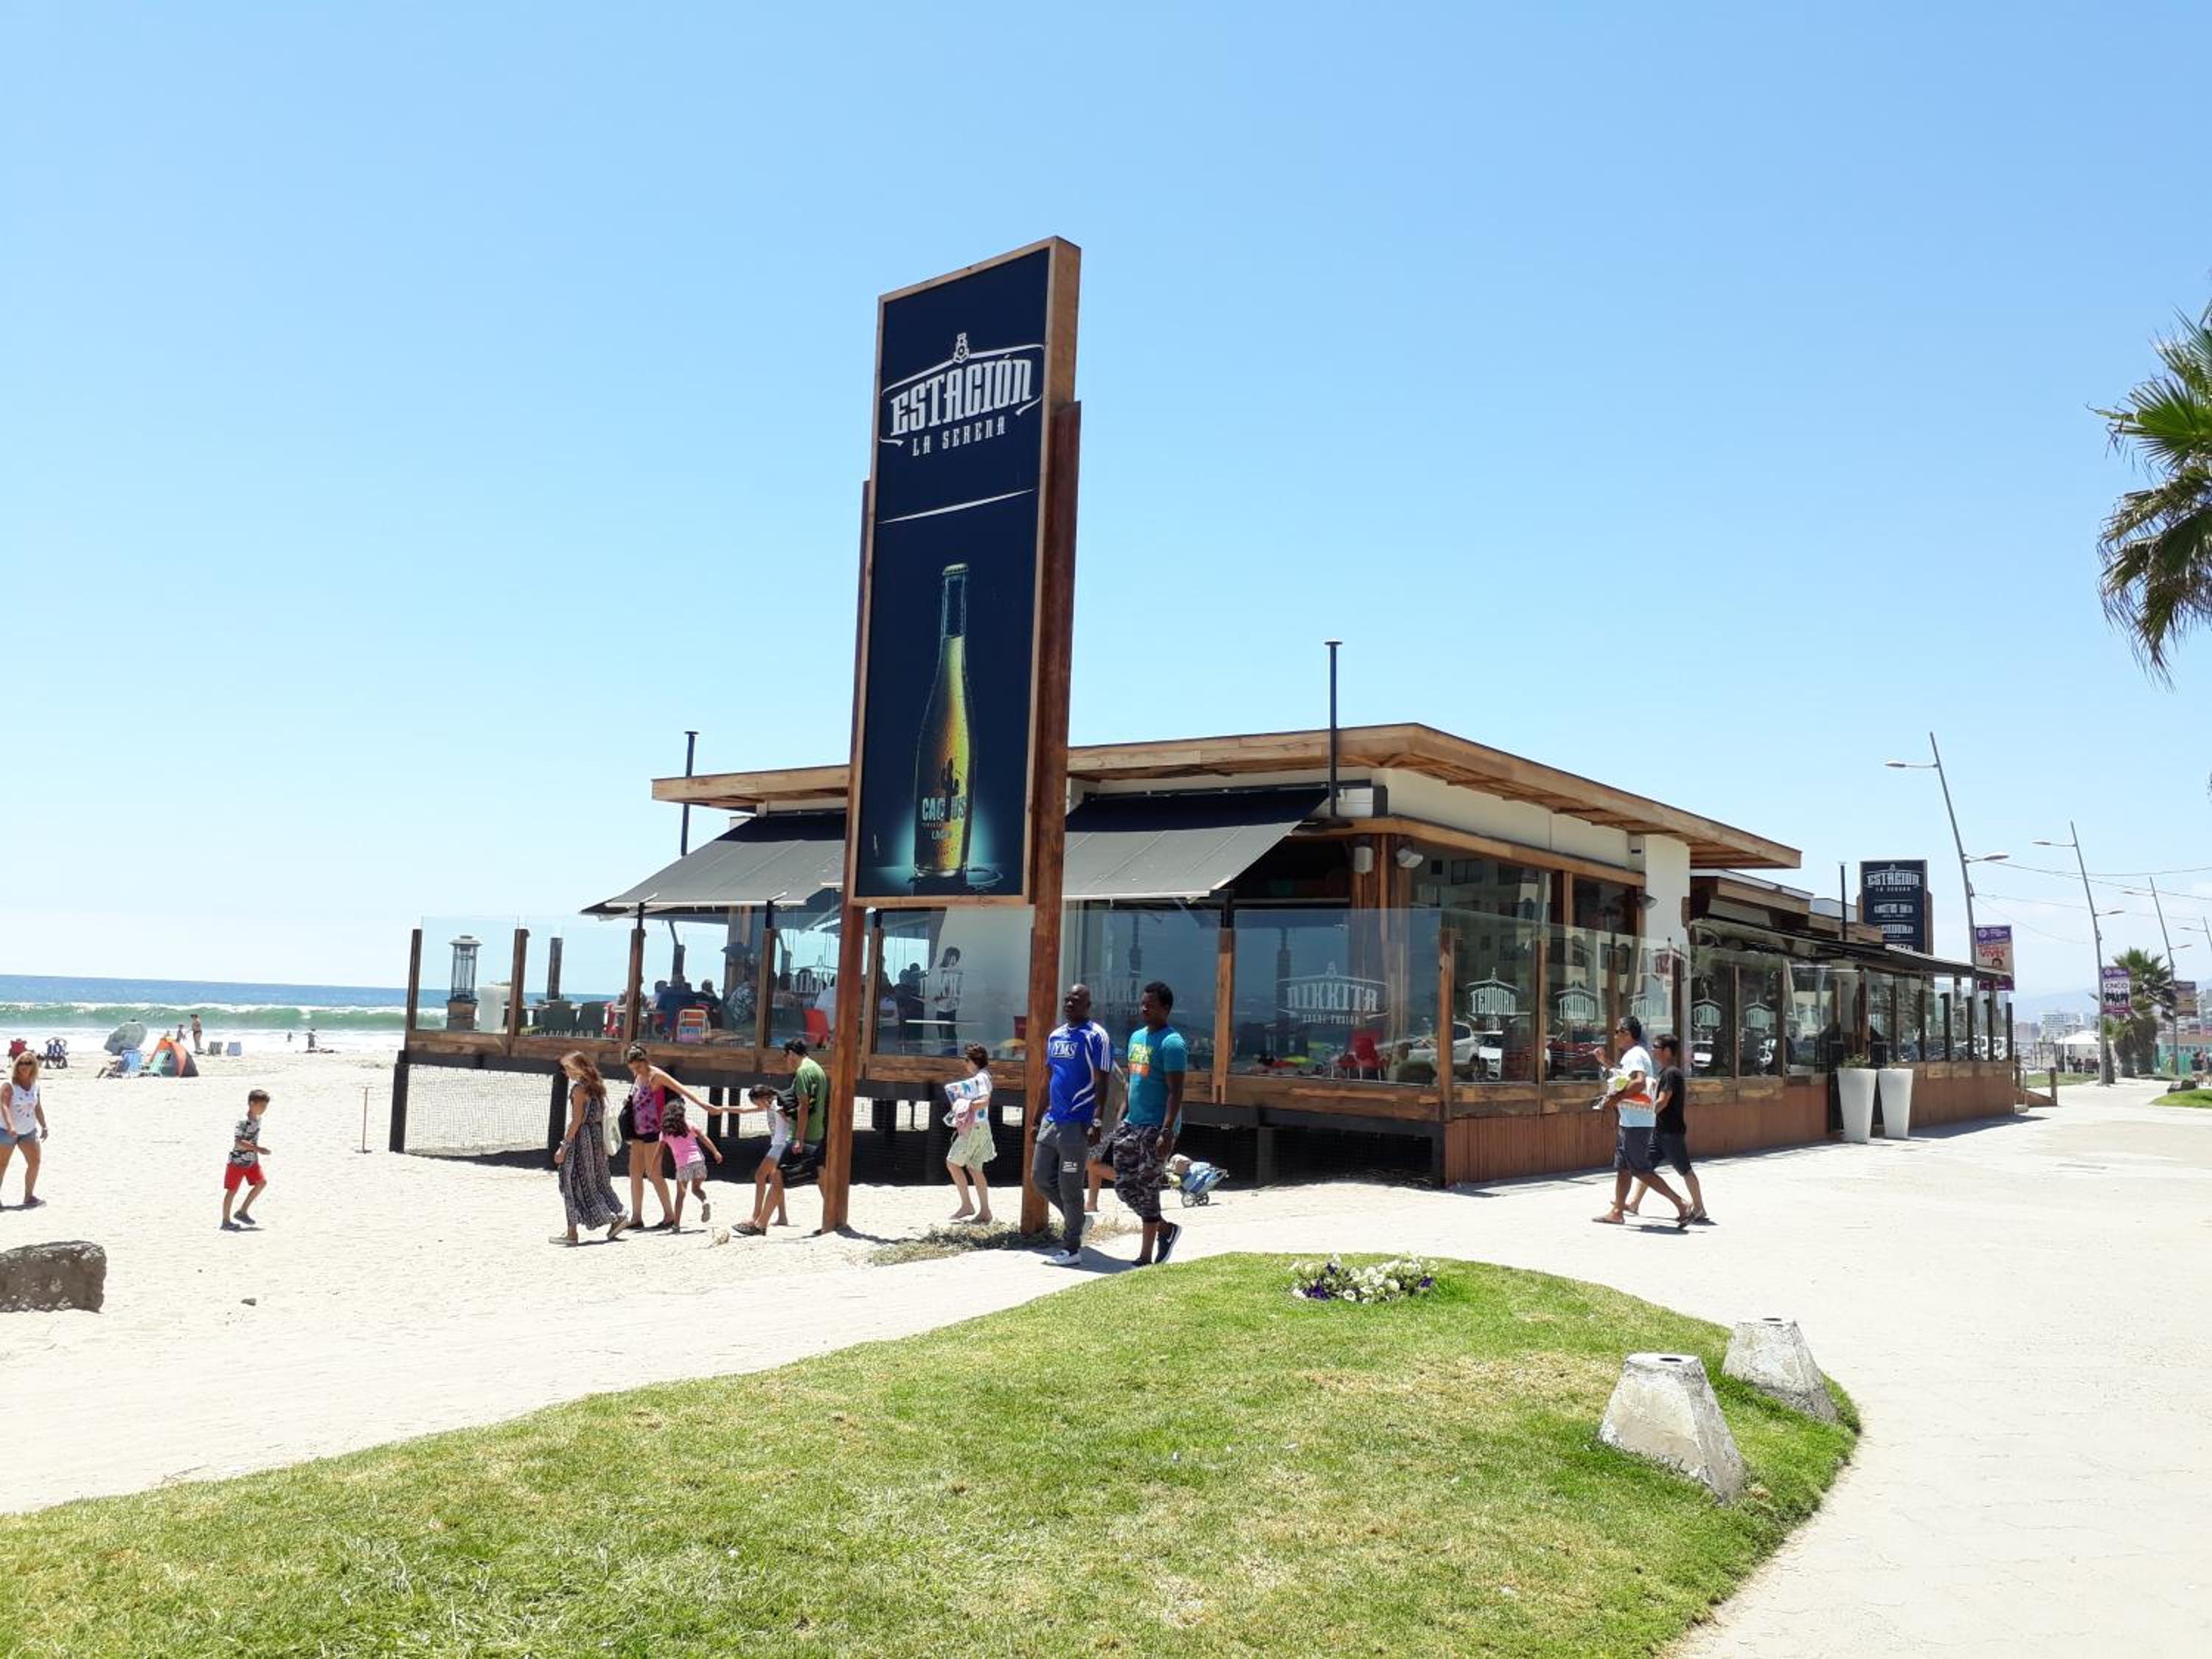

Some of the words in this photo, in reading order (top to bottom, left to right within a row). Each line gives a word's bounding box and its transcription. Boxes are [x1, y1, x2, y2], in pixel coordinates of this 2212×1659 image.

[890, 354, 1032, 437] ESTACIÓN
[912, 435, 931, 456] LA
[942, 415, 1005, 449] SERENA
[922, 797, 967, 821] CACUS
[1286, 981, 1377, 1012] NIKKITA
